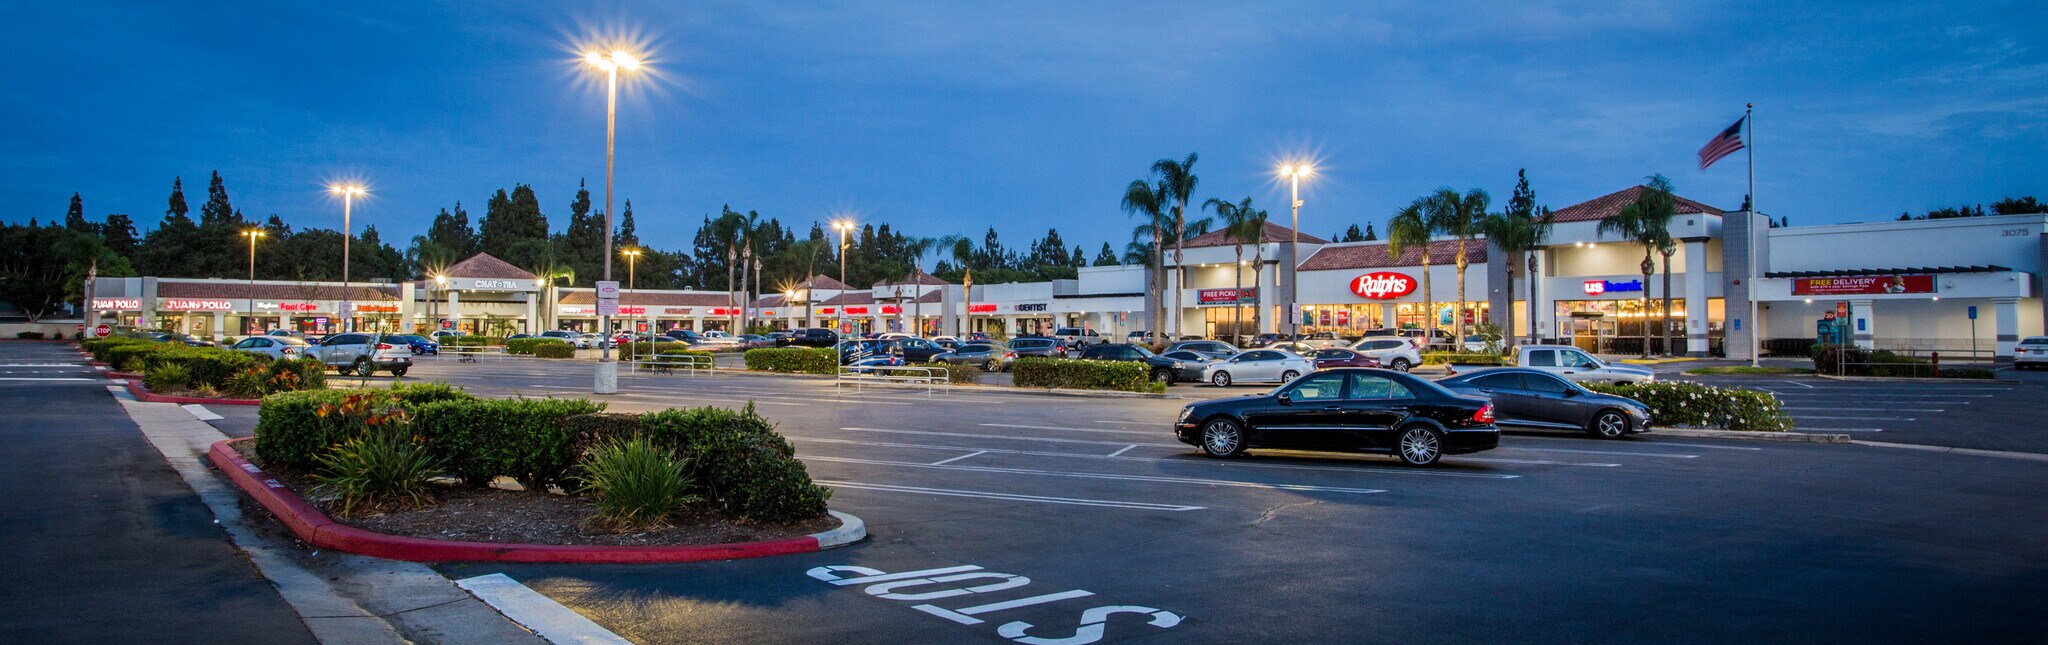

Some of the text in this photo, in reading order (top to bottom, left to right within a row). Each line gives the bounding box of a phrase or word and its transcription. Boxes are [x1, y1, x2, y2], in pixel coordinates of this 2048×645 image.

[1358, 275, 1408, 297] Ralphs
[92, 300, 138, 308] JUAN POLLO
[167, 300, 232, 310] JUAN POLLO
[1019, 303, 1048, 312] DENTIST
[806, 565, 1187, 645] STOP
